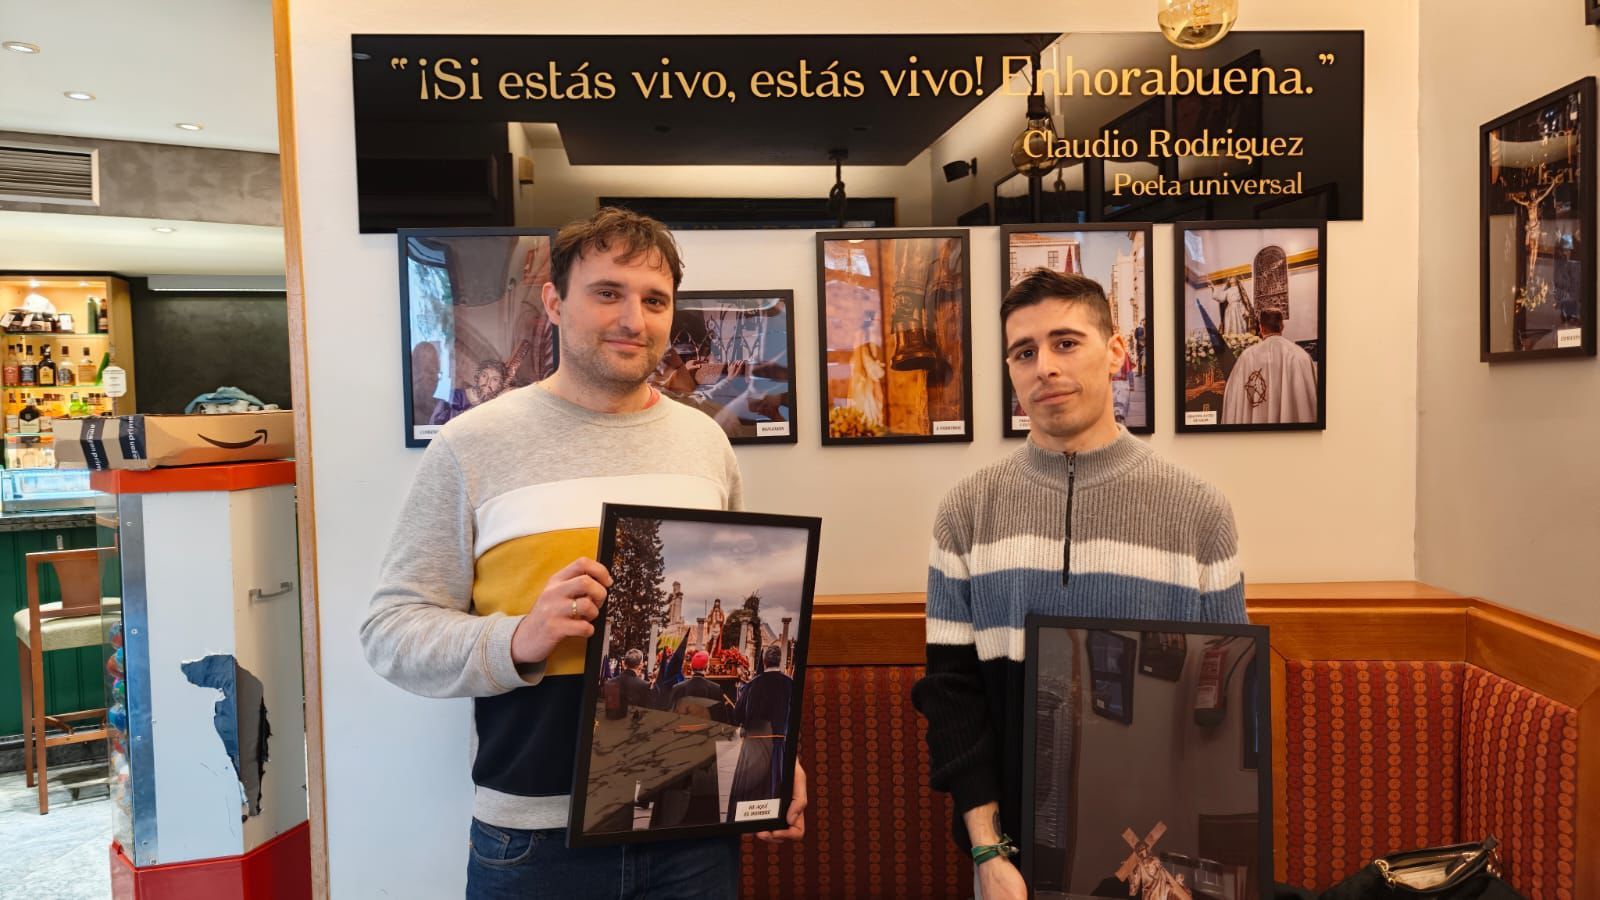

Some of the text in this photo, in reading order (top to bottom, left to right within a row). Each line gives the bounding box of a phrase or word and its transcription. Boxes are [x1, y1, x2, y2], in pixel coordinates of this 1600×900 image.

[498, 61, 616, 100] estás
[631, 57, 736, 103] vivo,
[750, 59, 865, 98] estás
[880, 55, 984, 97] vivo!
[1022, 128, 1304, 165] Claudio Rodriguez
[1112, 171, 1303, 196] Poeta universal
